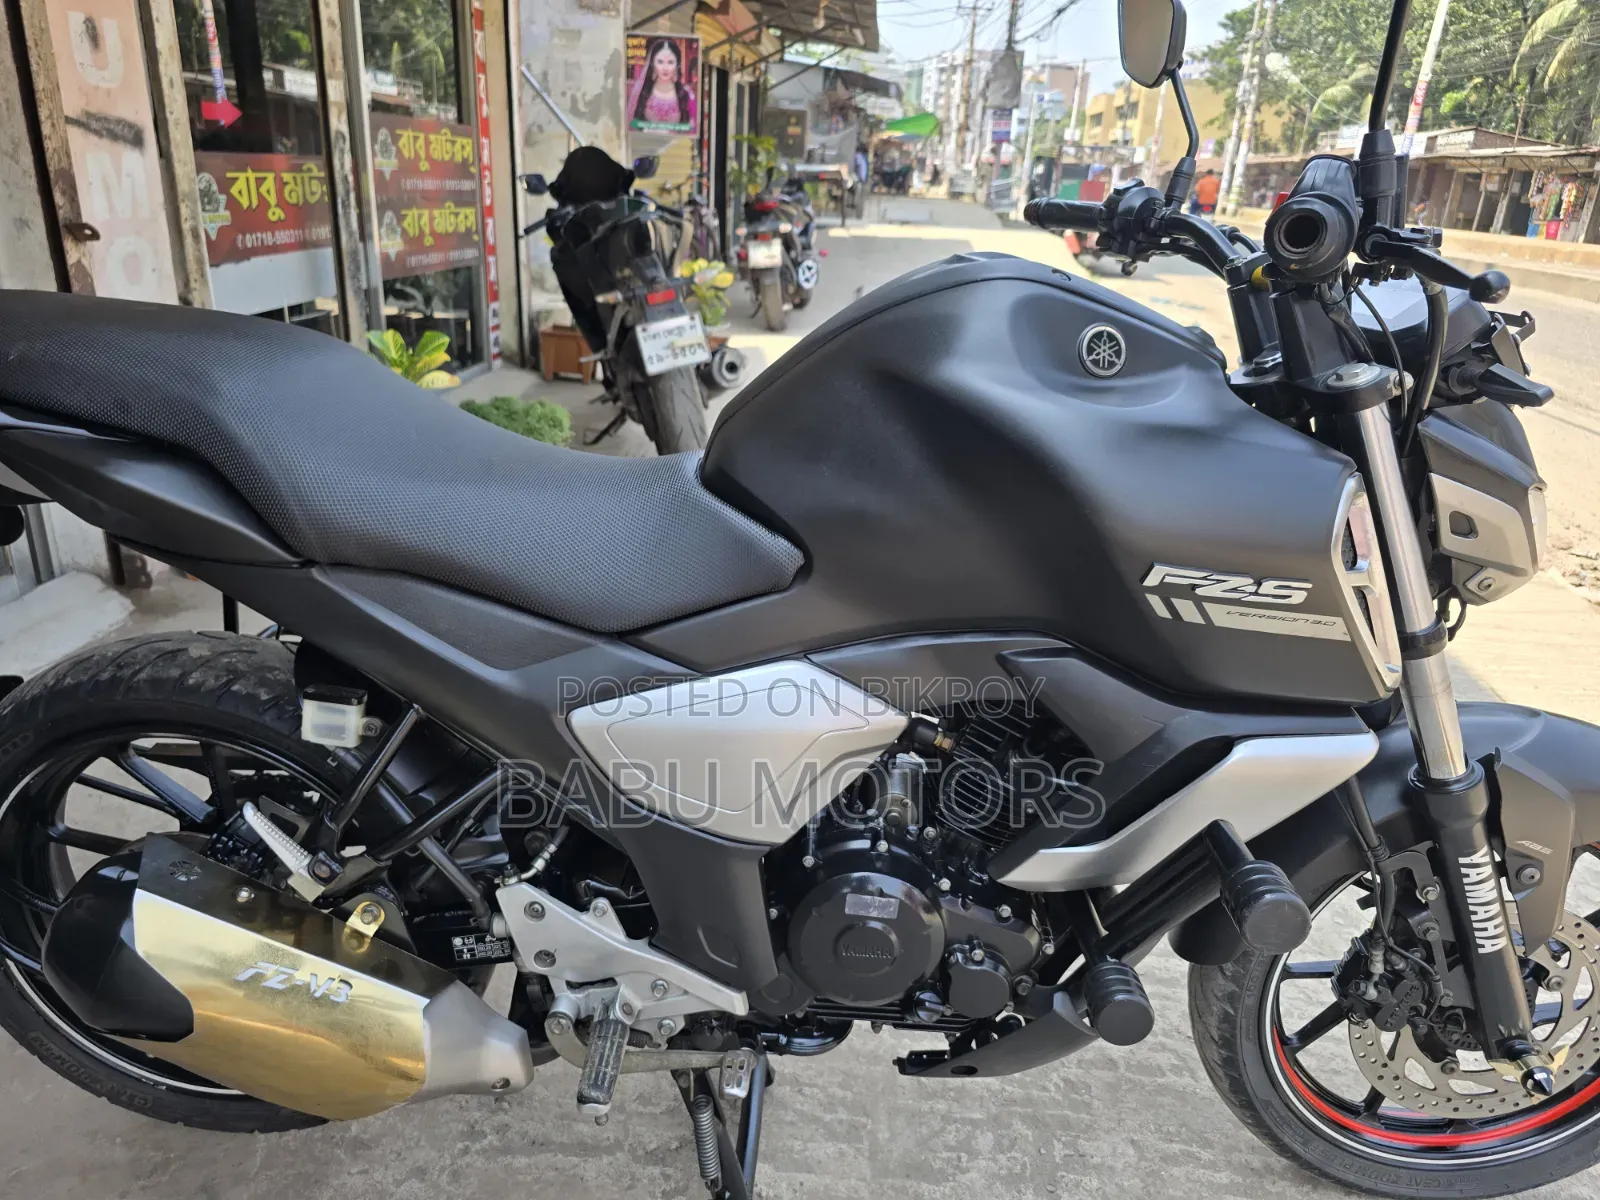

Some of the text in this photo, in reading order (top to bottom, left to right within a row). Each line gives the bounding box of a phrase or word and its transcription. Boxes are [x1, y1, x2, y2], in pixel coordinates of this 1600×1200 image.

[395, 126, 430, 172] বাবু
[225, 165, 286, 222] বাবু
[401, 205, 435, 247] বাবু
[1458, 847, 1508, 954] YAMAHA
[841, 943, 892, 960] YAMAHA
[234, 961, 354, 1003] FZ-V3
